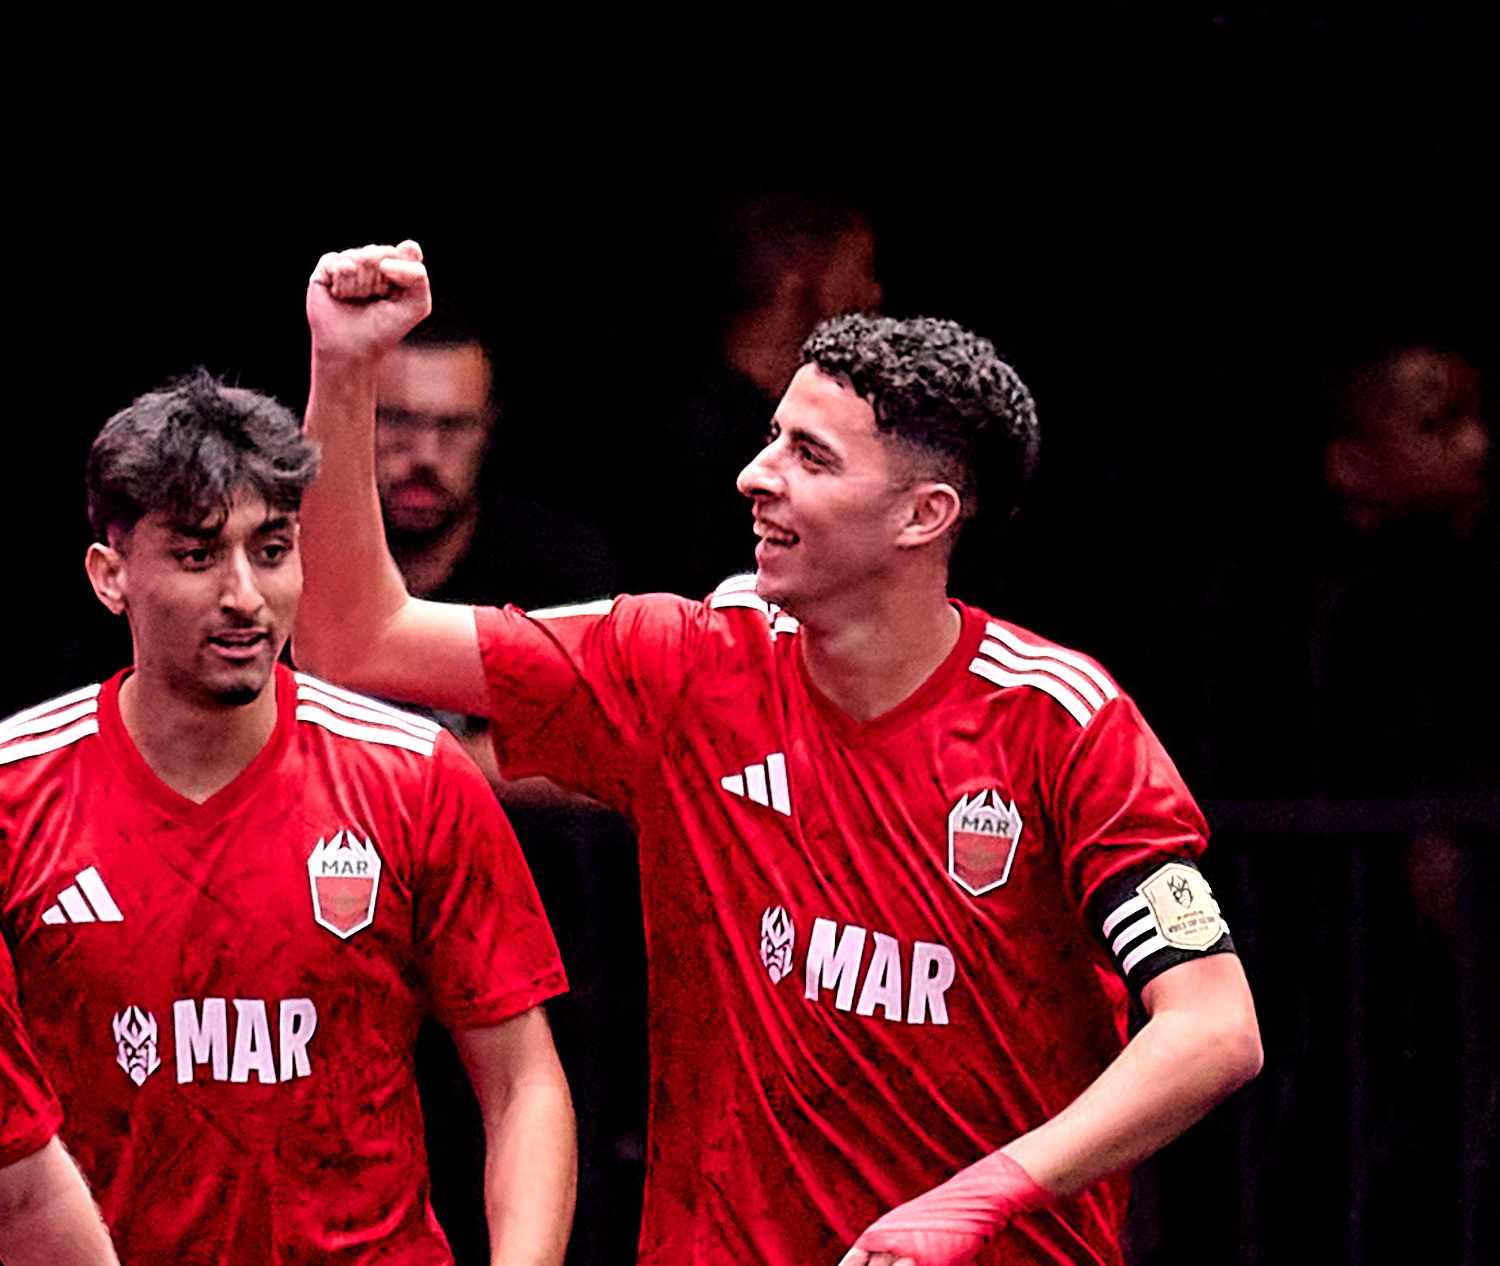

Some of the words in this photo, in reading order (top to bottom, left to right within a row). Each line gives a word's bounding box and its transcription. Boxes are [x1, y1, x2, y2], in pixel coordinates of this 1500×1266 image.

[961, 815, 1009, 834] MAR
[322, 860, 368, 875] MAR
[805, 917, 955, 1025] MAR
[173, 998, 318, 1084] MAR
